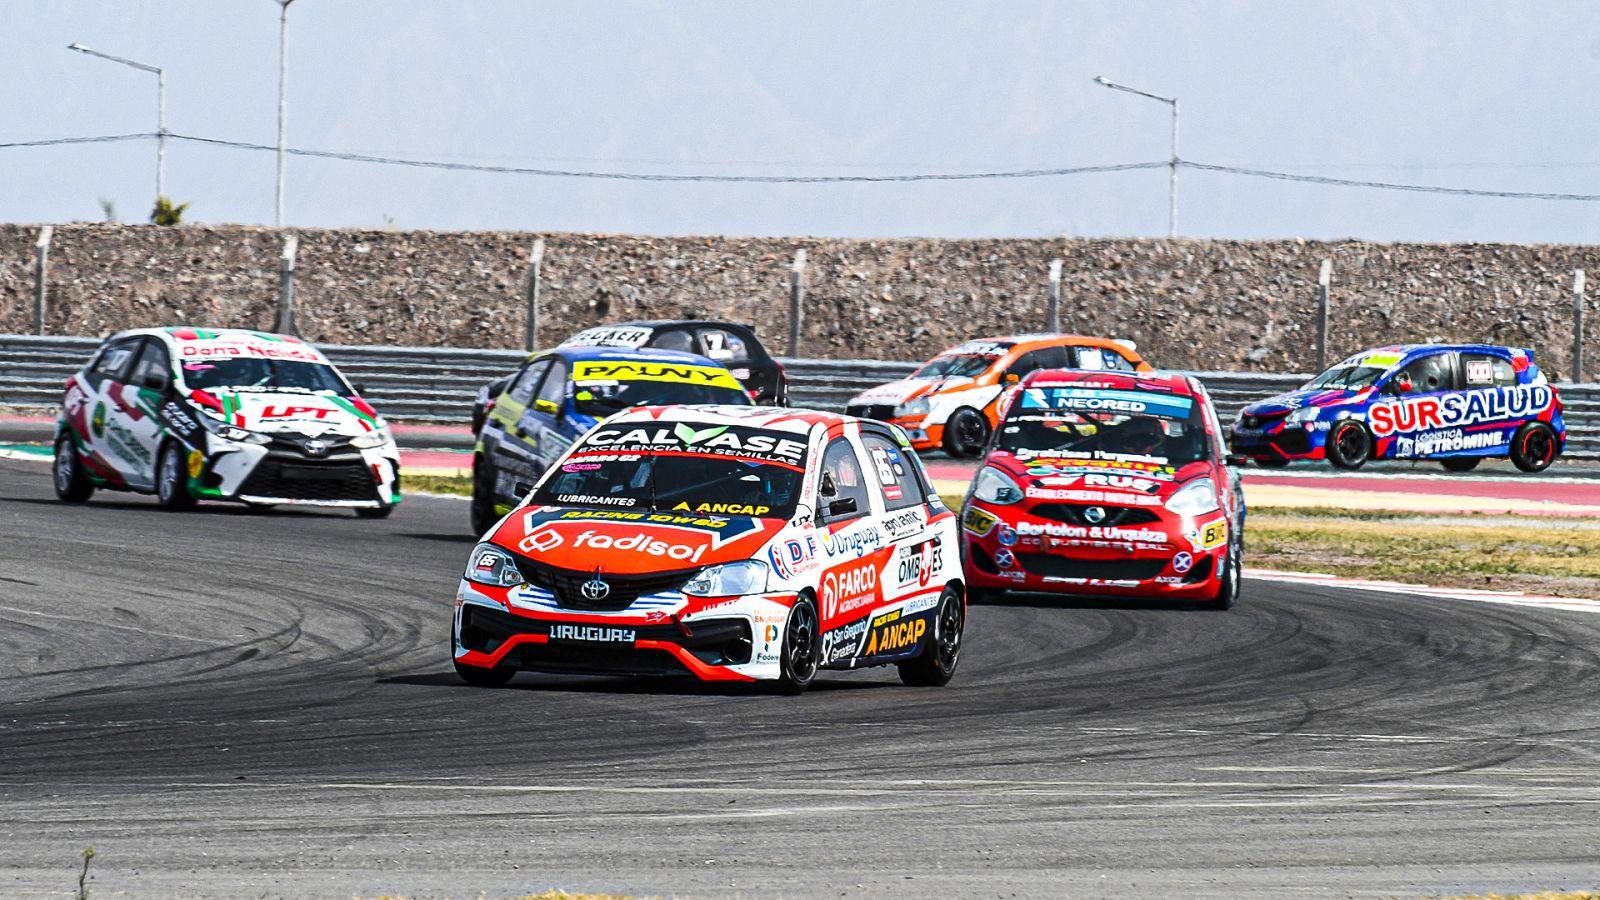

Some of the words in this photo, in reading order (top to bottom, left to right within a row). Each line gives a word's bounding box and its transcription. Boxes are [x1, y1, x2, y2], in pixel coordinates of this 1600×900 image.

[261, 405, 340, 419] LPT
[1058, 397, 1147, 411] NEORED
[1371, 388, 1552, 435] SURSALUD
[577, 444, 680, 454] EXCELENCIA
[688, 446, 711, 454] EN
[713, 448, 799, 466] SEMILLAS
[1083, 473, 1159, 491] RUS
[556, 494, 637, 507] LUBRICANTES
[695, 503, 770, 517] ANCAP
[559, 511, 645, 520] RACING
[834, 526, 880, 558] Uruguay
[1089, 526, 1103, 538] &
[1103, 527, 1168, 543] Urquiza
[572, 530, 709, 564] fadisol
[838, 563, 877, 599] FARCO
[550, 625, 636, 642] URUGUAY
[878, 618, 927, 652] ANCAP
